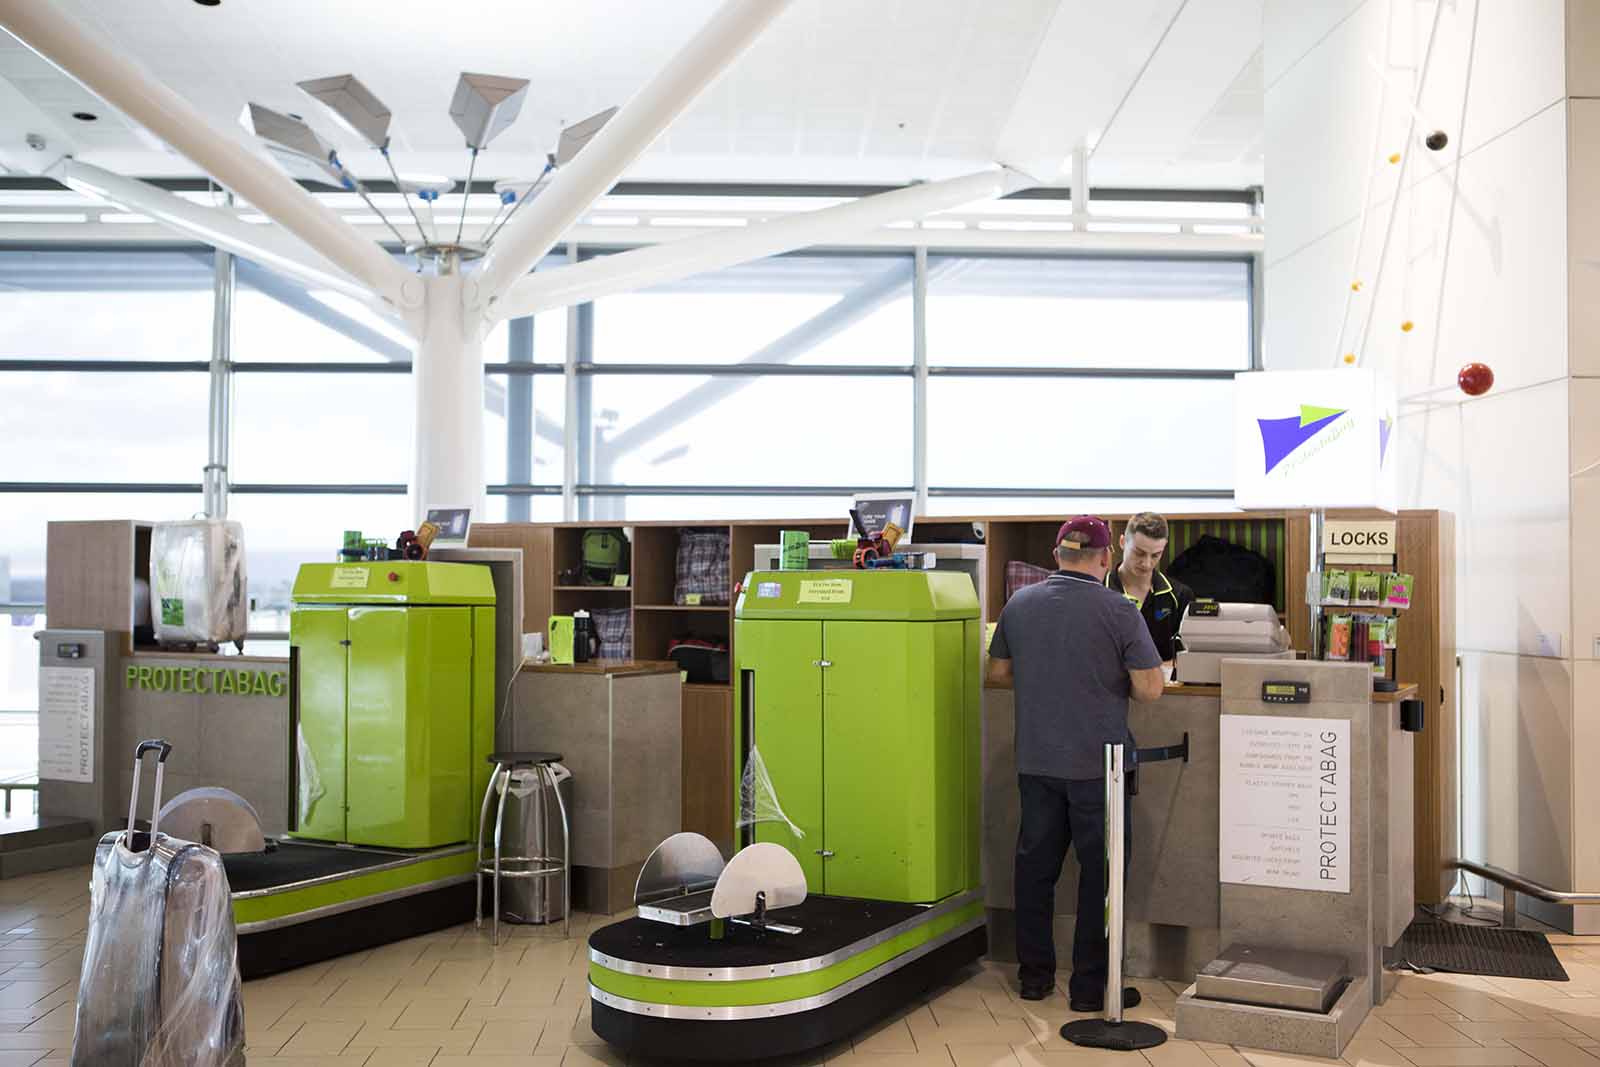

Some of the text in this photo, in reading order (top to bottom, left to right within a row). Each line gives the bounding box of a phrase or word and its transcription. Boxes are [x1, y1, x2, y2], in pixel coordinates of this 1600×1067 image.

[1331, 531, 1389, 546] LOCKS
[126, 664, 285, 697] PROTECTABAG
[1320, 731, 1337, 880] PROTECTABAG
